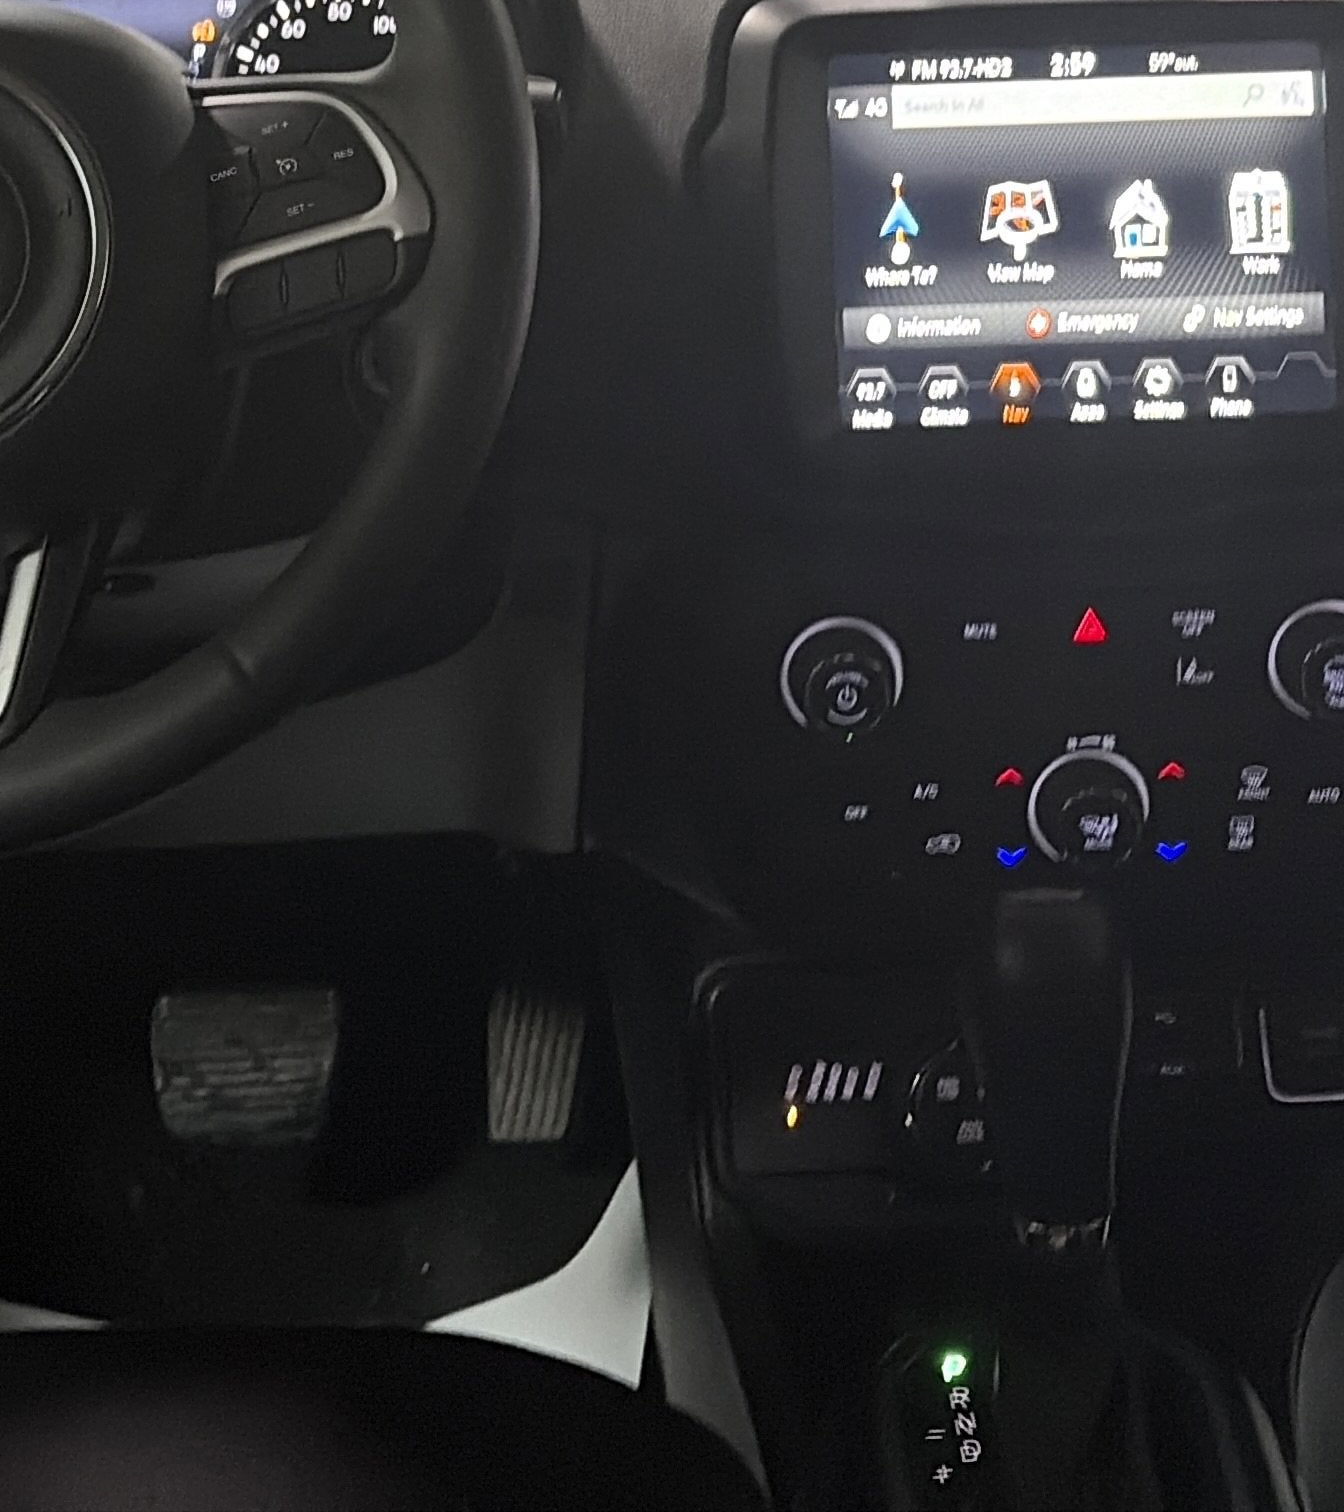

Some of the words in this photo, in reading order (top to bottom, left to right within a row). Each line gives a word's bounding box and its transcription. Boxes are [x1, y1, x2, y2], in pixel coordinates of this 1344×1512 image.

[327, 1, 352, 22] 80
[281, 19, 306, 40] 60
[254, 53, 280, 74] 40
[911, 58, 937, 81] FM
[1050, 51, 1097, 77] 2:59
[261, 124, 278, 136] SET
[333, 148, 354, 160] RES
[209, 166, 238, 182] CANC
[286, 204, 305, 216] SET
[897, 316, 982, 338] Information
[1057, 311, 1140, 334] Emergency
[1002, 404, 1030, 424] Nav
[949, 1386, 971, 1410] R
[954, 1411, 977, 1436] N
